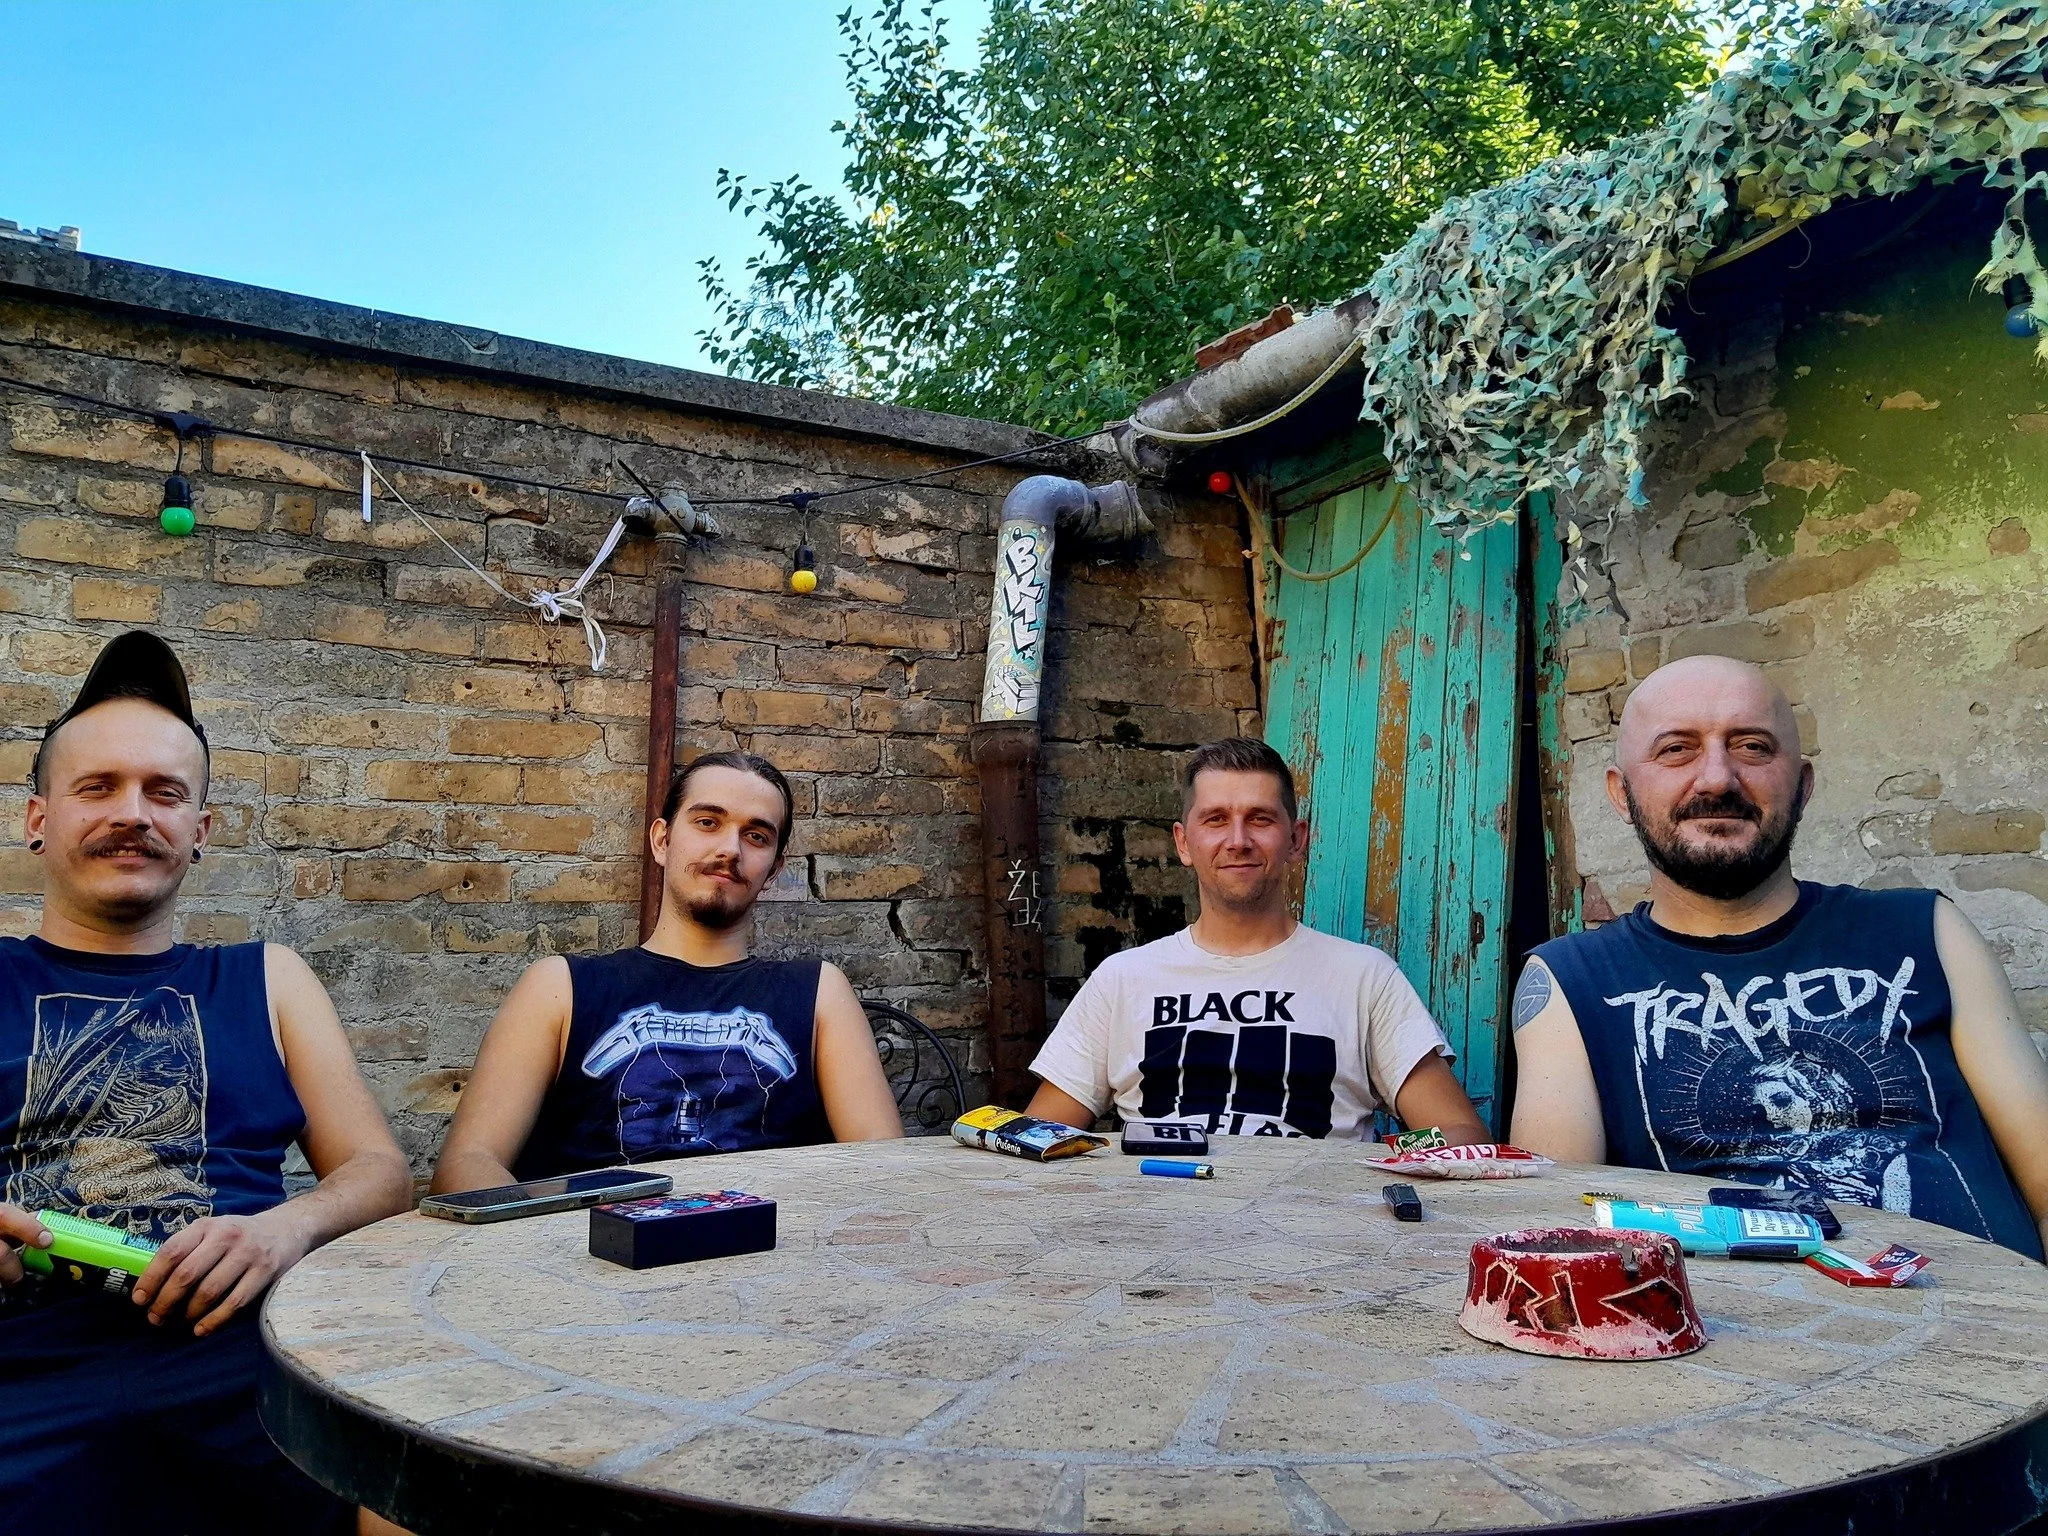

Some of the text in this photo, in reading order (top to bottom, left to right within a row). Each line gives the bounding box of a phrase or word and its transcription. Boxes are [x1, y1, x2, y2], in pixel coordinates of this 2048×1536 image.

[1152, 990, 1296, 1027] BLACK
[1603, 956, 1919, 1066] TRAGEDY
[996, 1137, 1021, 1155] Pušenje
